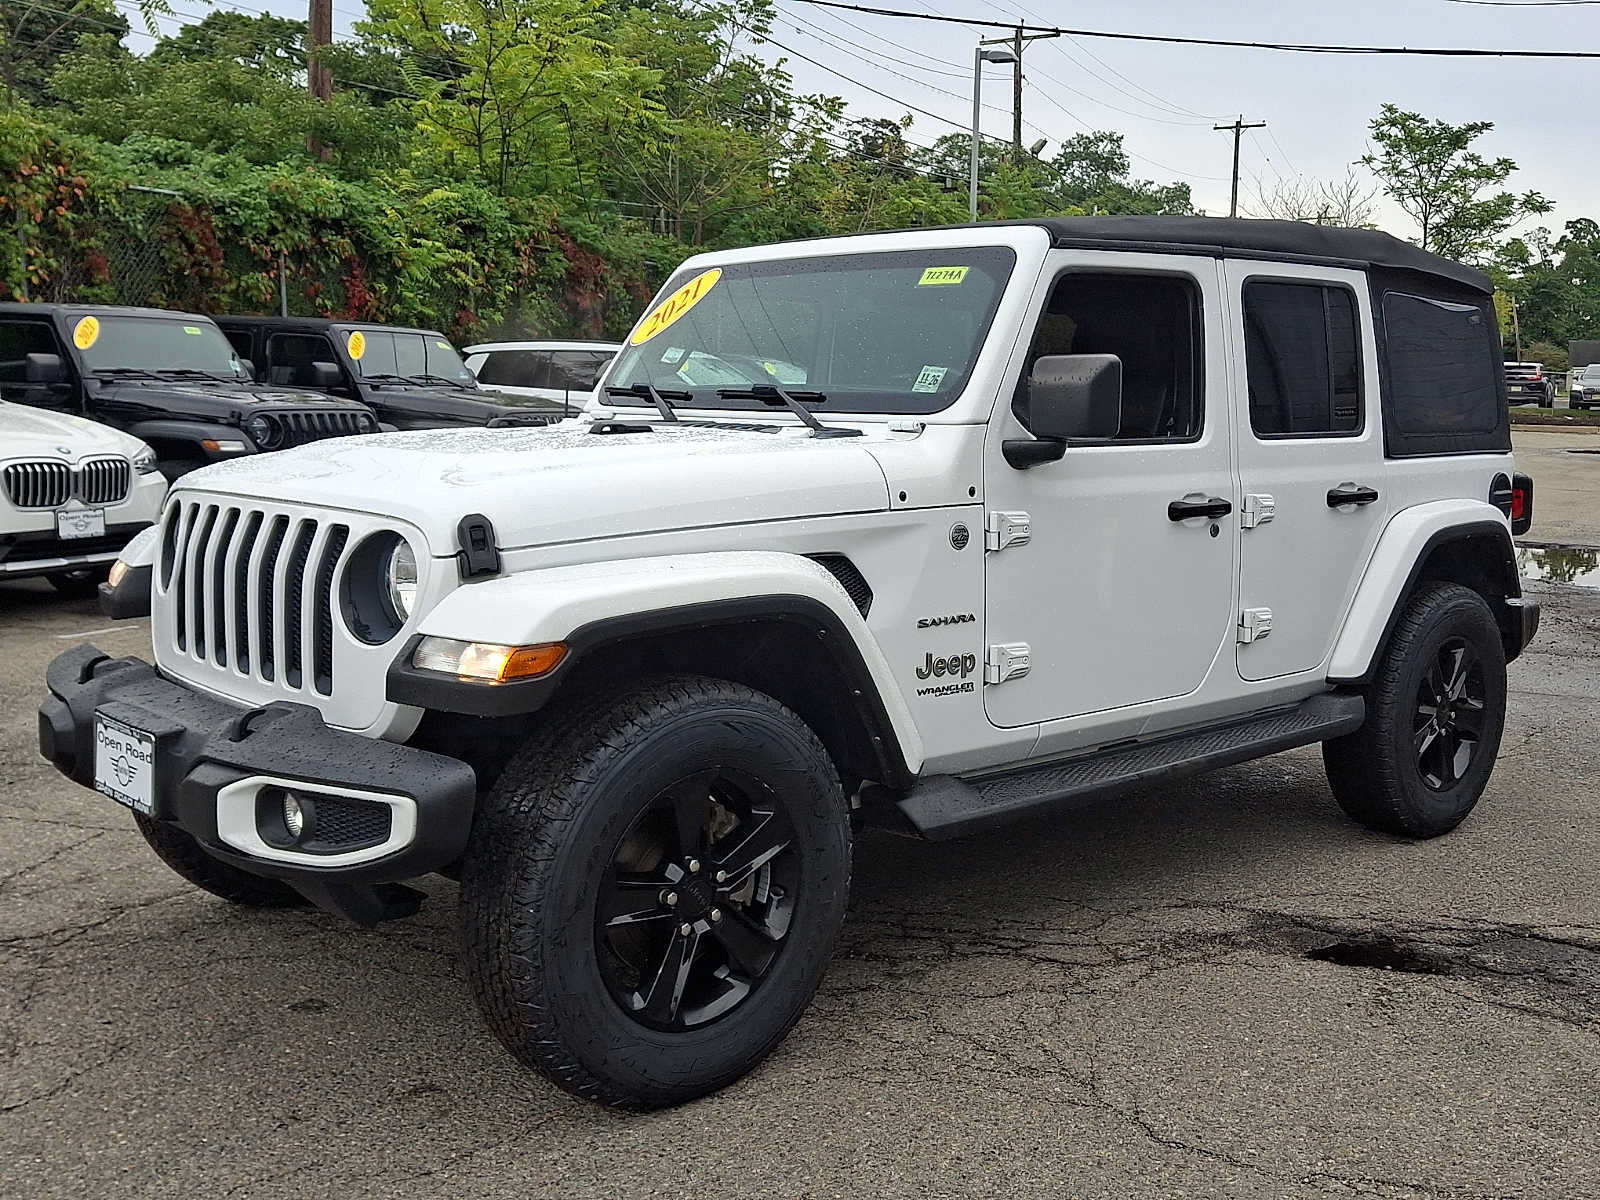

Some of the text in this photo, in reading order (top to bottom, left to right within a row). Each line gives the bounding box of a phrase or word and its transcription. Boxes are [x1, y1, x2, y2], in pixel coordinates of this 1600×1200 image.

[646, 277, 703, 337] 2021
[917, 613, 976, 628] SAHARA
[916, 652, 976, 679] Jeep
[916, 682, 974, 696] WRANGLER
[98, 731, 152, 765] Open Road
